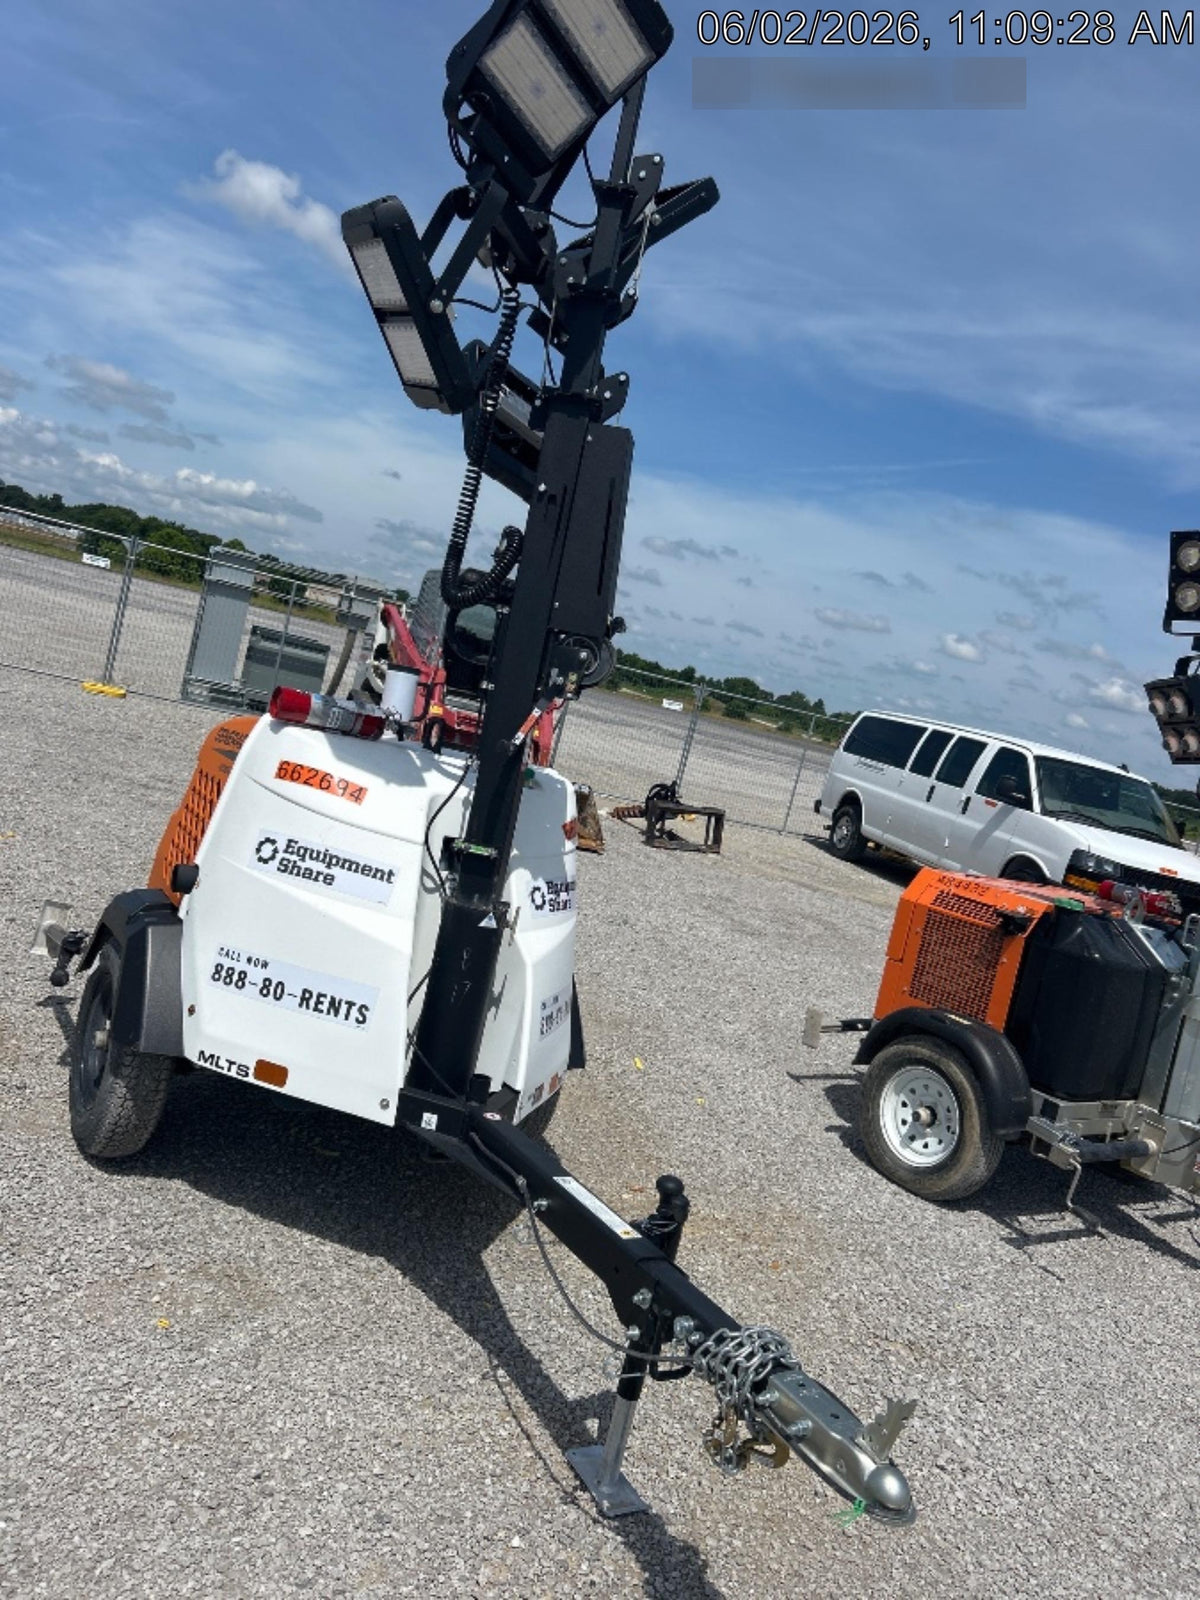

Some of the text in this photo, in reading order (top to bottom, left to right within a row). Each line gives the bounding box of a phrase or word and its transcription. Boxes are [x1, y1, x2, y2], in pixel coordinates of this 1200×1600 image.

[278, 760, 364, 803] 662694
[277, 857, 335, 886] Share
[282, 838, 395, 884] Equipment
[218, 947, 270, 970] CALL NOW
[211, 962, 370, 1025] 888-80-RENTS
[197, 1050, 250, 1078] MLTS
